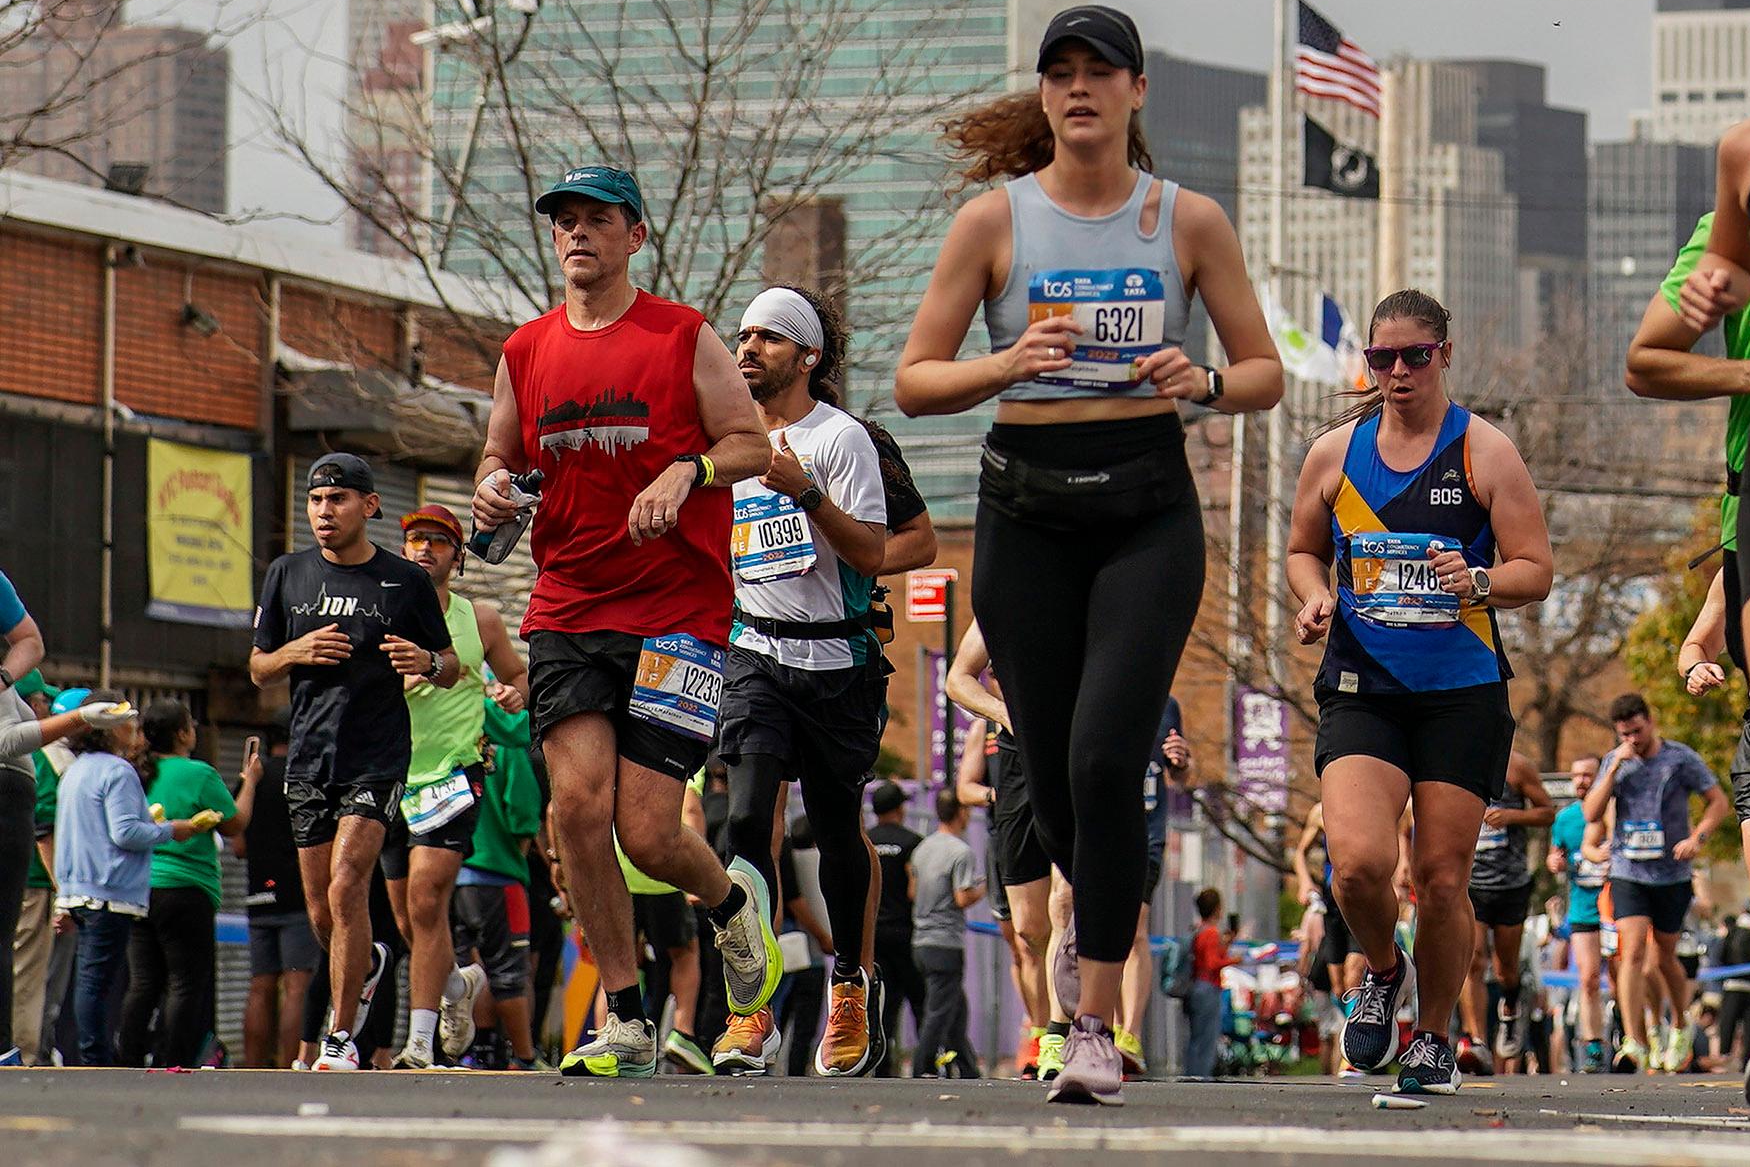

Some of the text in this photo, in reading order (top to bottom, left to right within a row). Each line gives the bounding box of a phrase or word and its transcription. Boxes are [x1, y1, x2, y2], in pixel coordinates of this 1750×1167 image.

[1044, 278, 1073, 298] tcs
[1096, 307, 1143, 343] 6321
[1430, 488, 1462, 505] BOS
[758, 516, 804, 549] 10399
[1362, 539, 1385, 553] tcs
[1398, 563, 1444, 591] 1248
[655, 639, 679, 652] tcs
[681, 666, 721, 706] 12233
